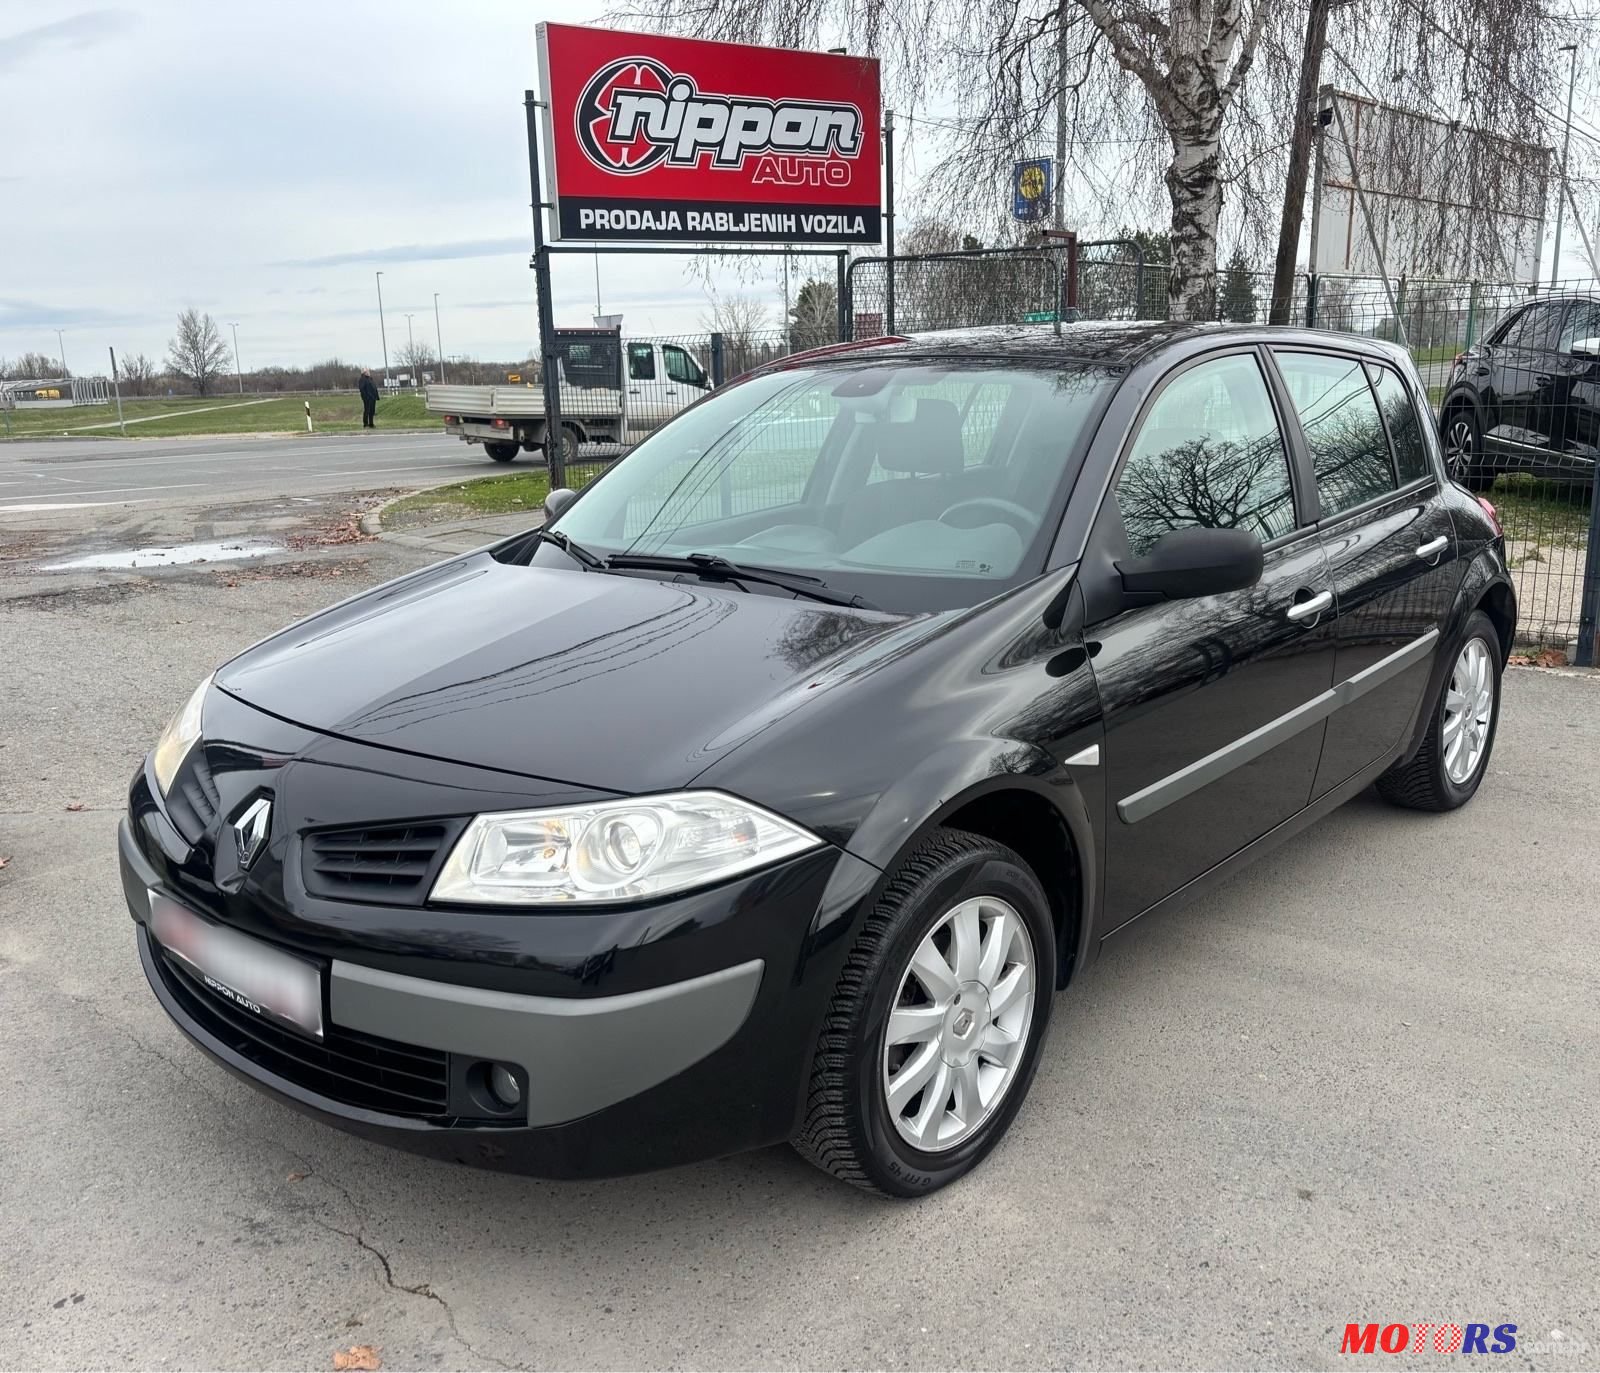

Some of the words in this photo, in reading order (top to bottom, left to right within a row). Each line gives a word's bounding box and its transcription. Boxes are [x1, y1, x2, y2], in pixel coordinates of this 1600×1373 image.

[610, 78, 861, 166] nippon
[752, 156, 851, 187] AUTO
[579, 208, 682, 231] PRODAJA
[687, 211, 797, 233] RABLJENIH
[800, 213, 866, 235] VOZILA
[204, 975, 235, 1000] NIPPON
[236, 994, 261, 1014] AUTO
